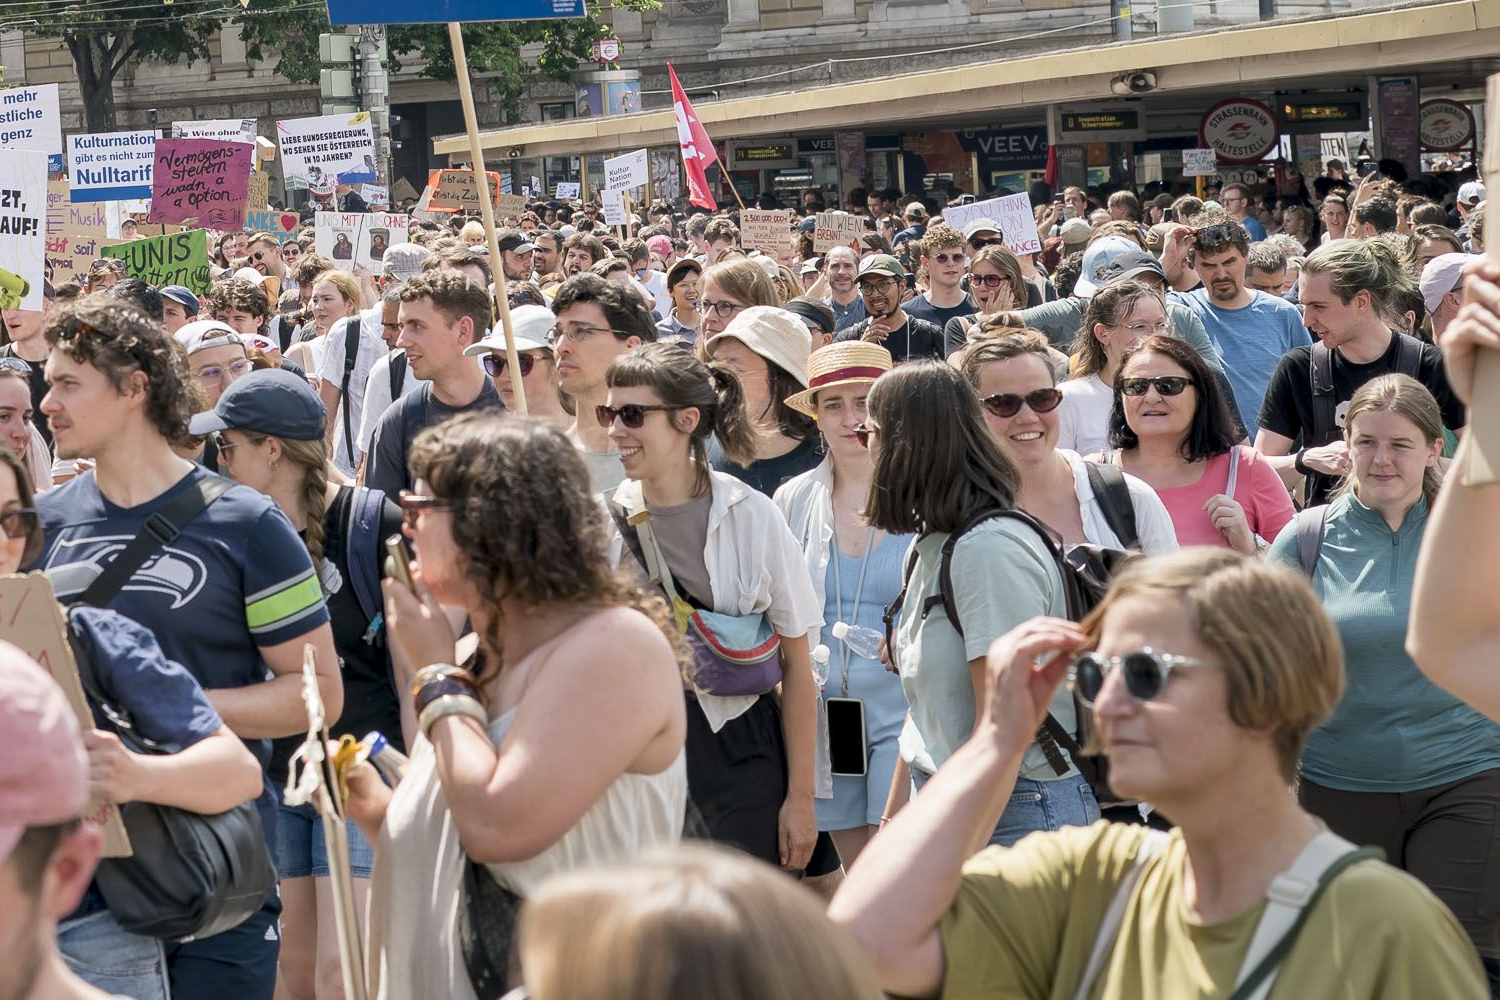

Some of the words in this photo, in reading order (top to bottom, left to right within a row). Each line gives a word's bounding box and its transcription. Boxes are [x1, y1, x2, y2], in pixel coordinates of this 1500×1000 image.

[3, 90, 38, 105] mehr
[1209, 107, 1270, 128] STRASSENBAHN
[74, 134, 156, 149] Kulturnation
[281, 135, 302, 144] LIEBE
[302, 128, 369, 142] BUNDESREGIERUNG,
[978, 134, 1039, 154] VEEV
[282, 147, 293, 155] WO
[293, 145, 316, 155] SEHEN
[317, 143, 329, 152] SIE
[329, 139, 372, 151] ÖSTERREICH
[1213, 137, 1268, 155] HALTESTELLE
[75, 153, 94, 165] gibt
[96, 153, 107, 161] es
[109, 151, 133, 160] nicht
[159, 147, 242, 171] Vermögens-
[304, 156, 312, 164] IN
[312, 155, 320, 163] 10
[321, 152, 353, 162] JAHREN?
[172, 160, 227, 182] steuern
[609, 166, 630, 177] Kultur
[609, 172, 632, 183] Nation
[161, 179, 206, 198] wadn
[215, 176, 225, 186] a
[610, 180, 631, 191] retten
[173, 198, 182, 208] a
[963, 203, 993, 221] YOU
[997, 196, 1028, 213] THINK
[70, 207, 106, 227] Musik
[341, 214, 360, 227] MIT
[384, 215, 407, 228] OHNE
[818, 214, 833, 229] UNI
[837, 215, 863, 232] WIEN
